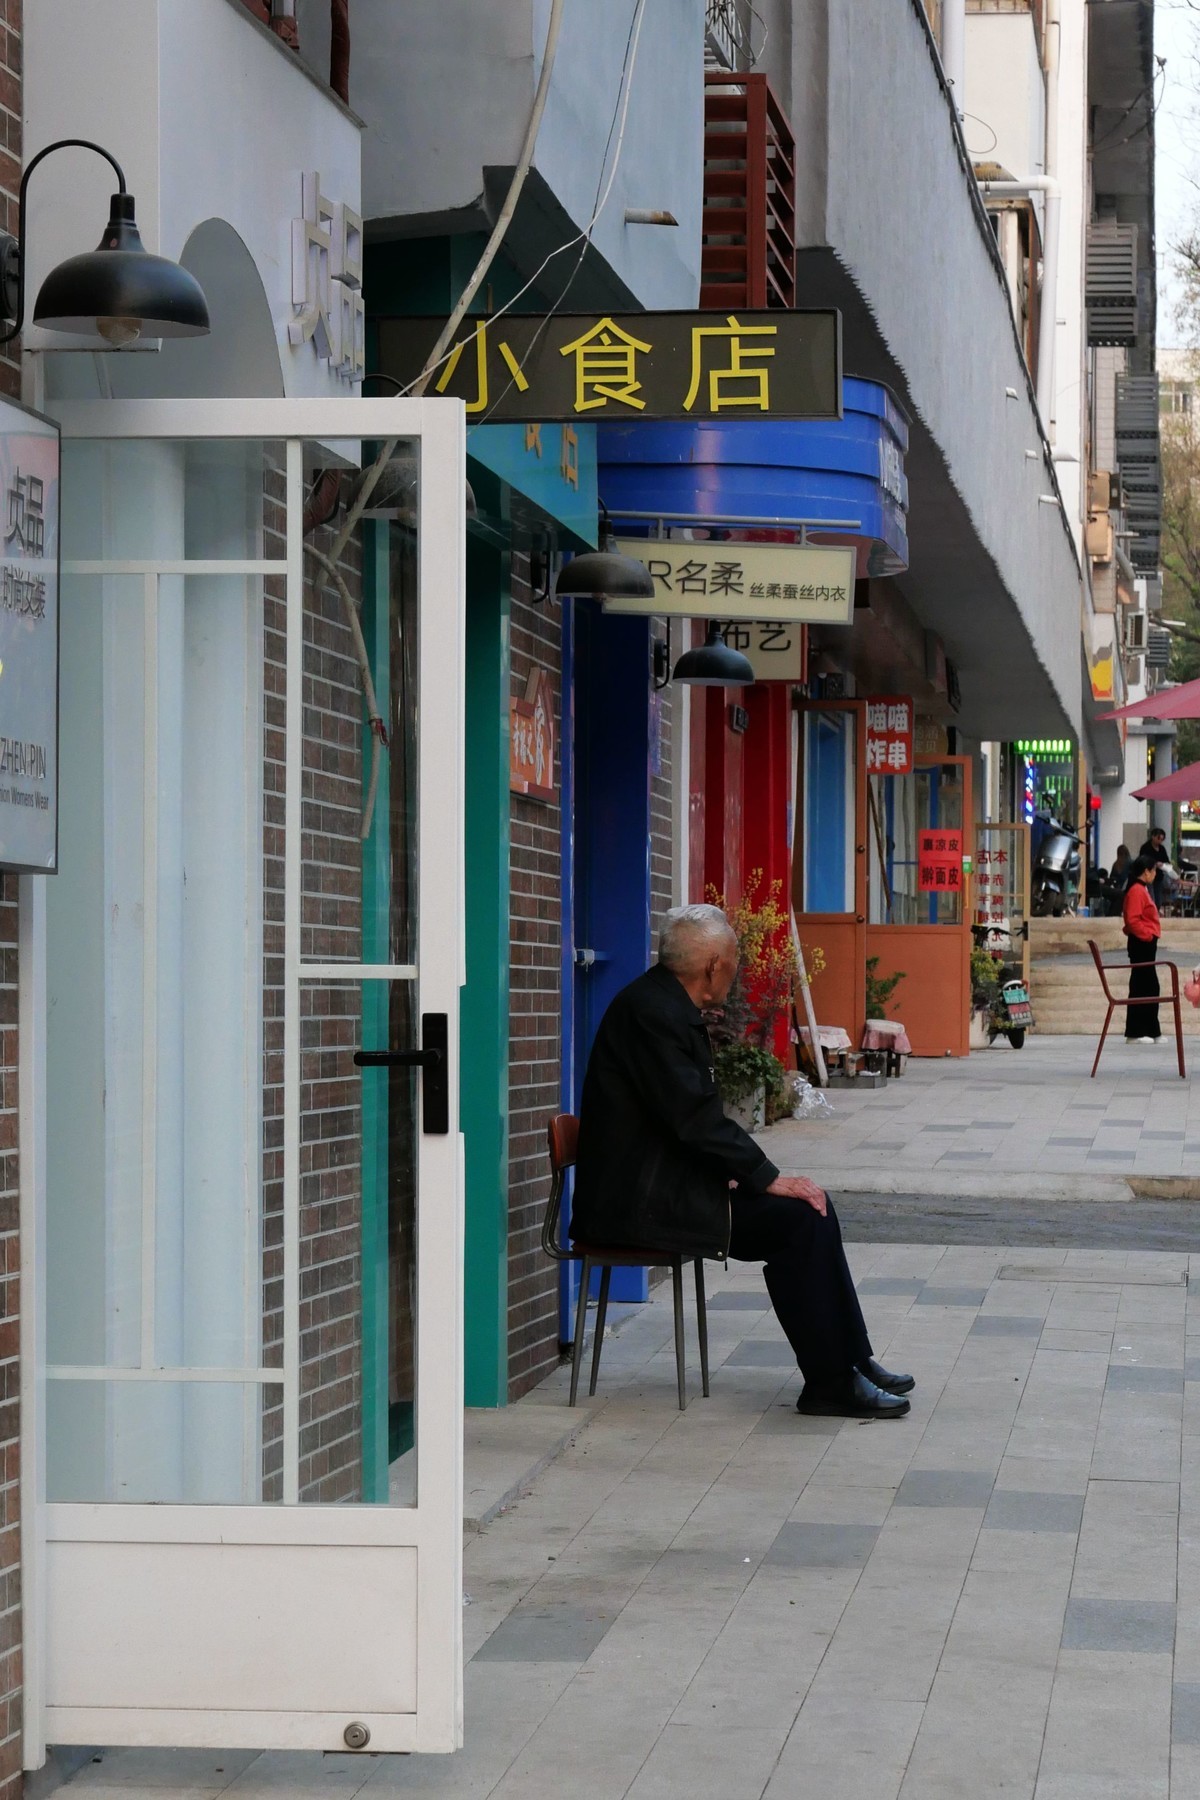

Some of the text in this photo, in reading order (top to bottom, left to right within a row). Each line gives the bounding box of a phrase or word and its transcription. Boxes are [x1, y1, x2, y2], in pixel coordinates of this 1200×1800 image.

[434, 315, 778, 413] 小食店
[3, 564, 46, 619] 时尚女装
[636, 560, 846, 602] R名柔 丝柔蚕丝内衣
[867, 703, 908, 733] 喵喵
[0, 737, 46, 779] ZHEN PIN
[866, 738, 907, 770] 炸串
[35, 791, 49, 811] Wear
